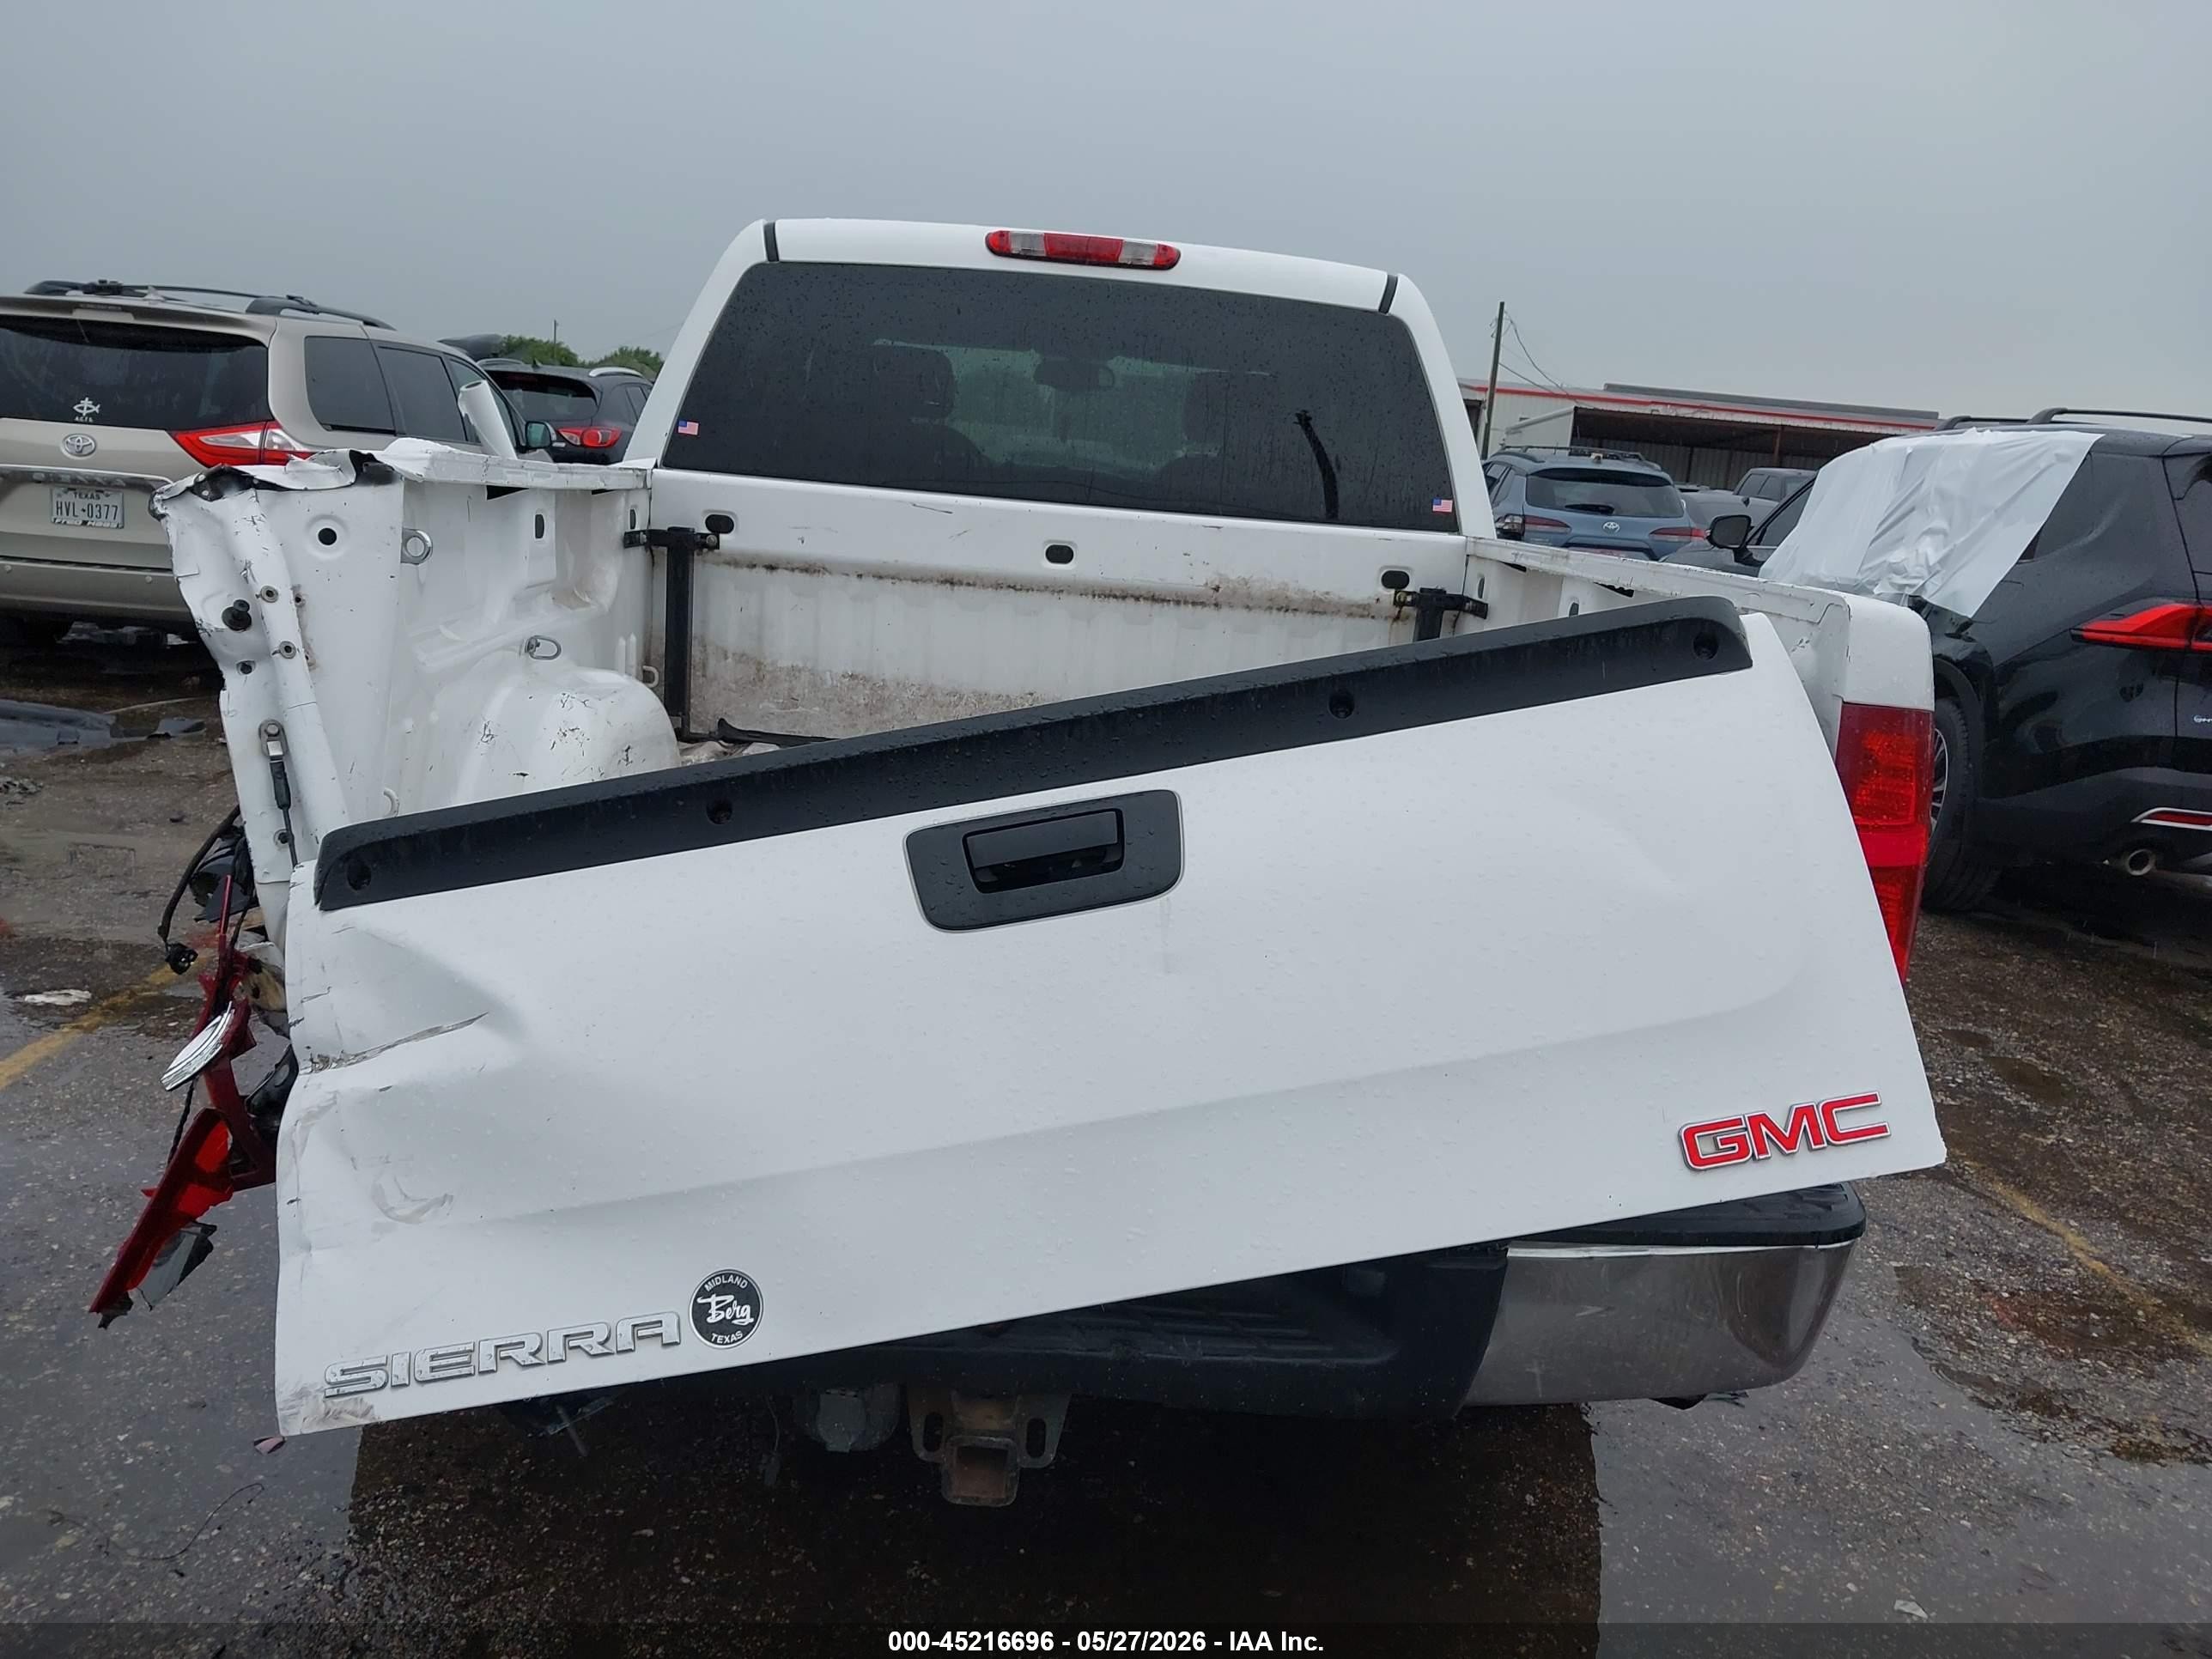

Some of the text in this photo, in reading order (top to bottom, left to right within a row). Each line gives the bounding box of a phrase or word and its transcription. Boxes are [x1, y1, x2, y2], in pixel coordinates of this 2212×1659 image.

[73, 491, 101, 501] TEXAS
[1678, 1091, 1892, 1171] GMC
[704, 1274, 749, 1292] MIDLAND
[696, 1293, 755, 1326] Berg
[711, 1330, 744, 1345] TEXAS
[324, 1311, 681, 1399] SIERRA
